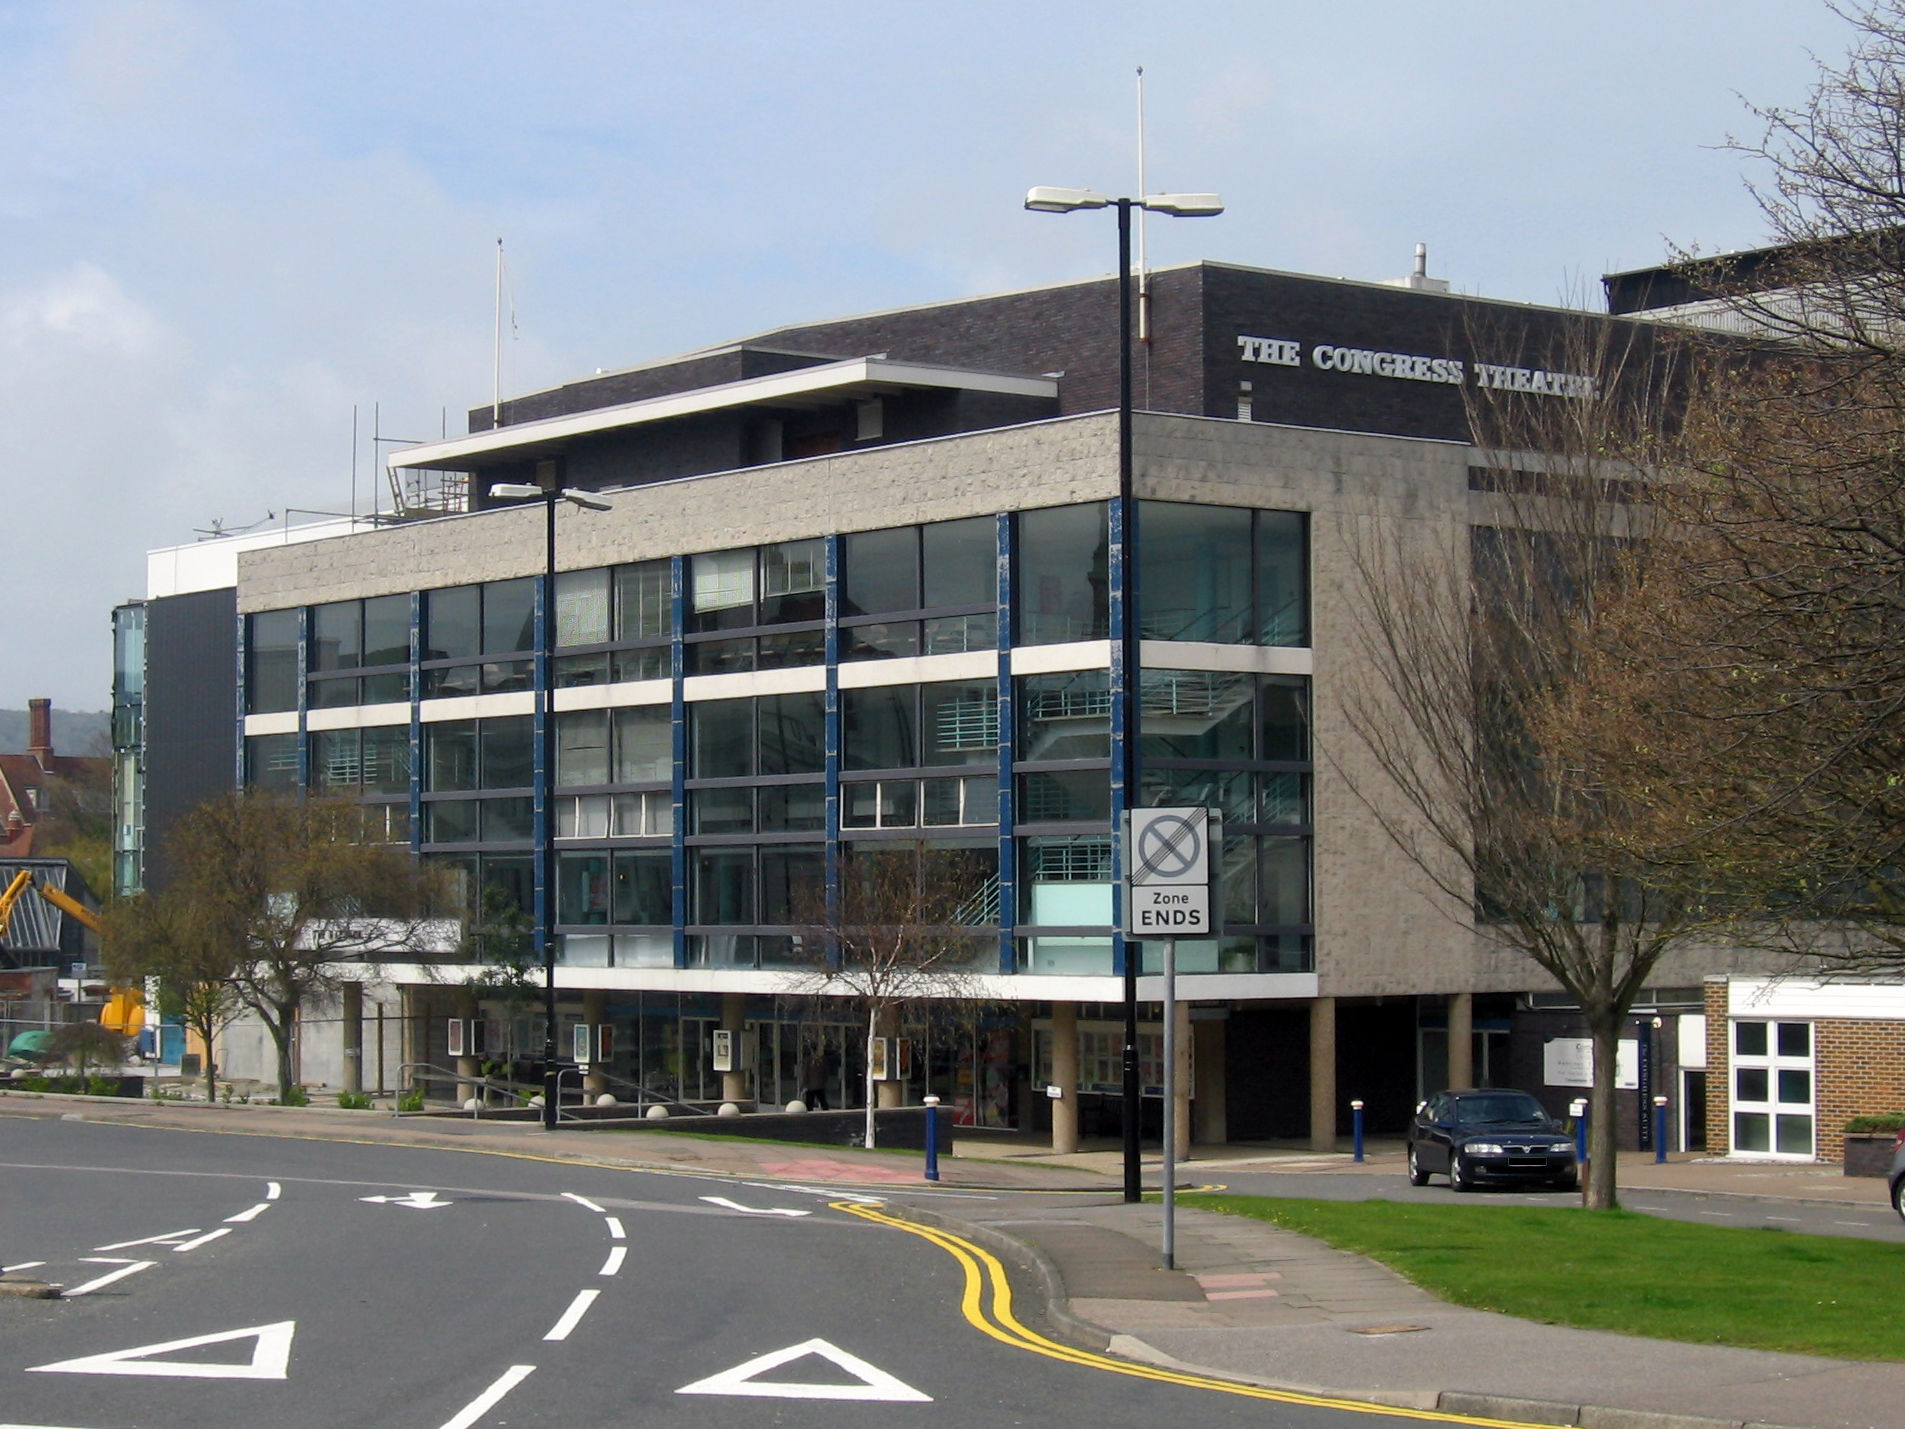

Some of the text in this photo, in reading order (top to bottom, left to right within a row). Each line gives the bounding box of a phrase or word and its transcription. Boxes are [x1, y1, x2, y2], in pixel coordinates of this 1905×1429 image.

[1237, 335, 1300, 366] THE
[1312, 344, 1464, 385] CONGRESS
[1153, 892, 1189, 905] Zone
[1142, 909, 1200, 926] ENDS
